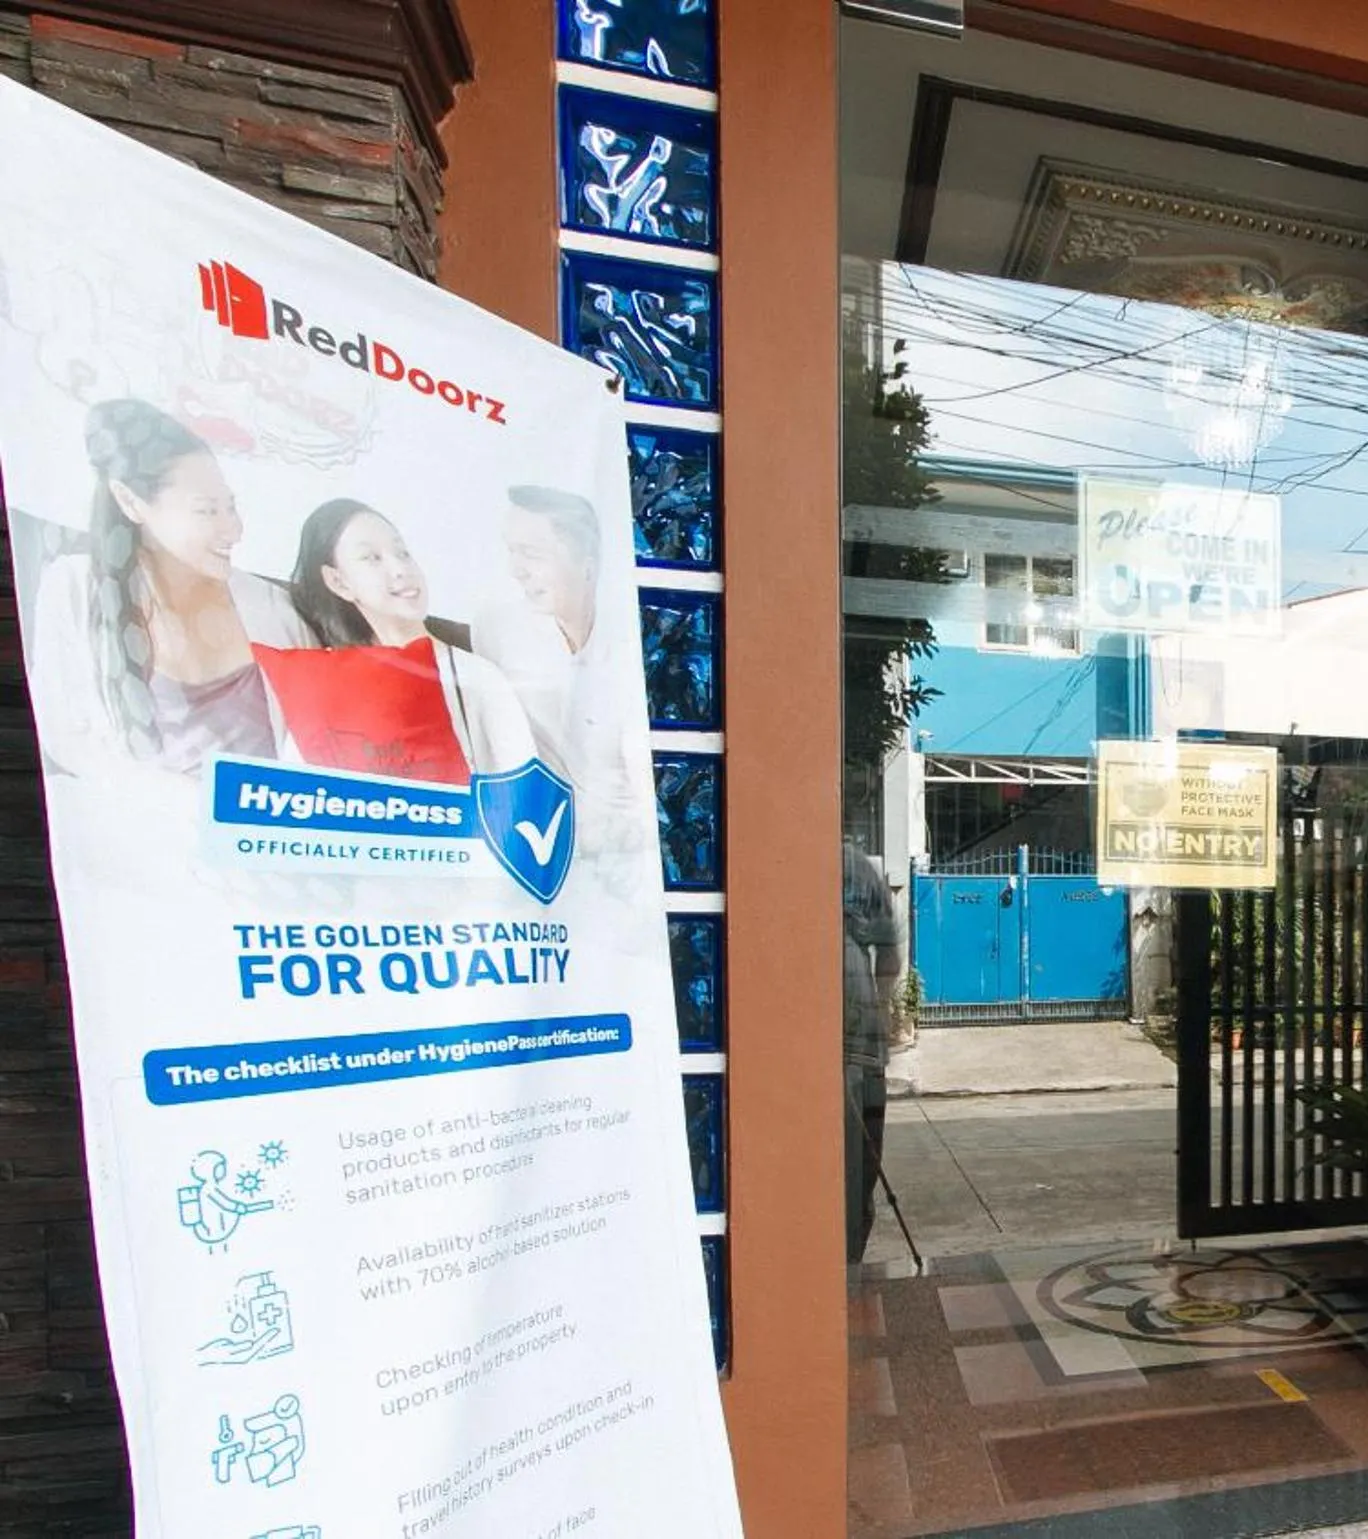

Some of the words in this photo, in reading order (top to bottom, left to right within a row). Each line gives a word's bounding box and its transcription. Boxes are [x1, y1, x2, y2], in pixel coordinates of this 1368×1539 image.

[271, 299, 507, 426] RedDoorz
[1166, 530, 1236, 563] COME
[1244, 537, 1268, 565] IN
[1098, 564, 1270, 625] OPEN
[238, 783, 463, 826] HygienePass
[1180, 791, 1263, 805] PROTECTIVE
[1181, 806, 1214, 816] FACE
[1218, 807, 1255, 818] MASK
[237, 839, 359, 860] OFFICIALLY
[368, 847, 471, 864] CERTIFIED
[1114, 830, 1159, 852] NO
[1171, 831, 1262, 857] ENTRY
[233, 924, 306, 949] THE
[314, 923, 444, 948] GOLDEN
[451, 922, 569, 945] STANDARD
[238, 952, 366, 1000] FOR
[379, 948, 571, 995] QUALITY
[165, 1064, 220, 1087] The
[223, 1052, 343, 1081] checklist
[345, 1046, 416, 1070] under
[418, 1034, 536, 1062] HygienePass
[338, 1124, 407, 1151] Usage
[413, 1119, 435, 1138] of
[342, 1144, 442, 1180] products
[449, 1137, 486, 1159] and
[565, 1117, 584, 1134] for
[345, 1168, 458, 1205] sanitation
[356, 1232, 475, 1276] Availability
[576, 1189, 632, 1213] stations
[360, 1274, 412, 1302] with
[417, 1261, 463, 1288] 70%
[552, 1216, 608, 1244] solution
[375, 1344, 474, 1389] Checking
[380, 1385, 439, 1417] upon
[516, 1321, 578, 1359] property
[397, 1477, 451, 1513] Filling
[489, 1425, 534, 1460] health
[537, 1395, 605, 1436] condition
[606, 1379, 634, 1404] and
[401, 1498, 451, 1539] travel
[496, 1443, 552, 1482] surveys
[555, 1423, 593, 1452] upon
[593, 1394, 656, 1433] check-in
